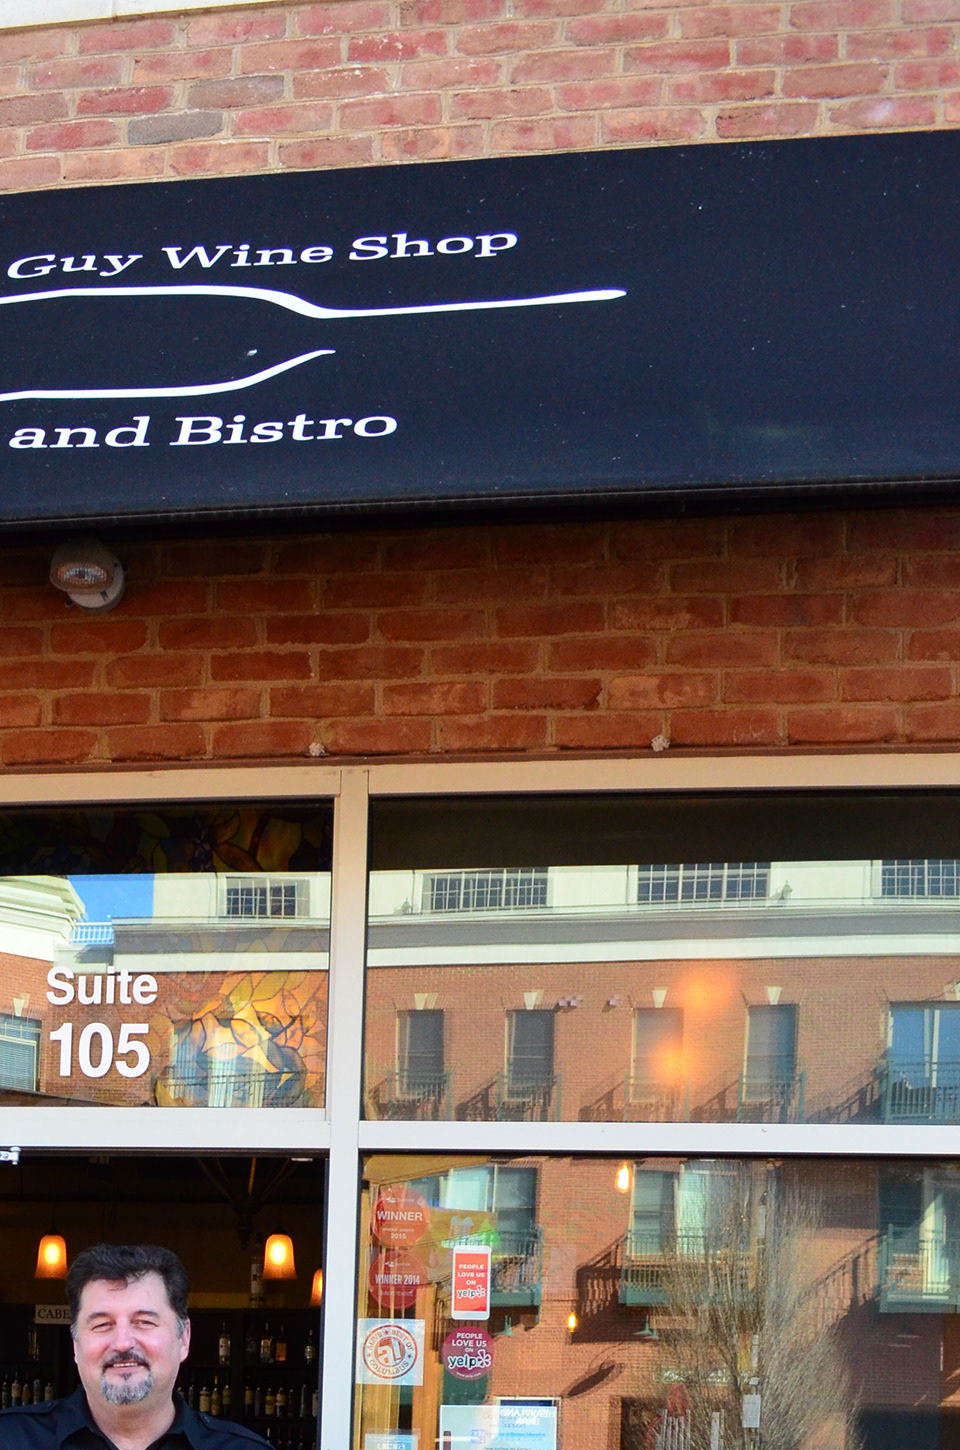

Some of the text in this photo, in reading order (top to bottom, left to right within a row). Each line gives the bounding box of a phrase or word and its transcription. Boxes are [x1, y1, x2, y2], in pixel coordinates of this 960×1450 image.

[6, 253, 143, 279] Guy
[161, 243, 334, 270] Wine
[348, 232, 519, 261] Shop
[8, 415, 151, 449] and
[168, 413, 399, 446] Bistro
[46, 965, 158, 1006] Suite
[49, 1022, 151, 1079] 105
[377, 1210, 423, 1221] WINNER
[390, 1232, 407, 1240] 2015
[375, 1274, 421, 1285] WINNER 2014
[456, 1287, 477, 1299] yelp
[456, 1332, 483, 1340] PEOPLE
[448, 1353, 478, 1370] yelp
